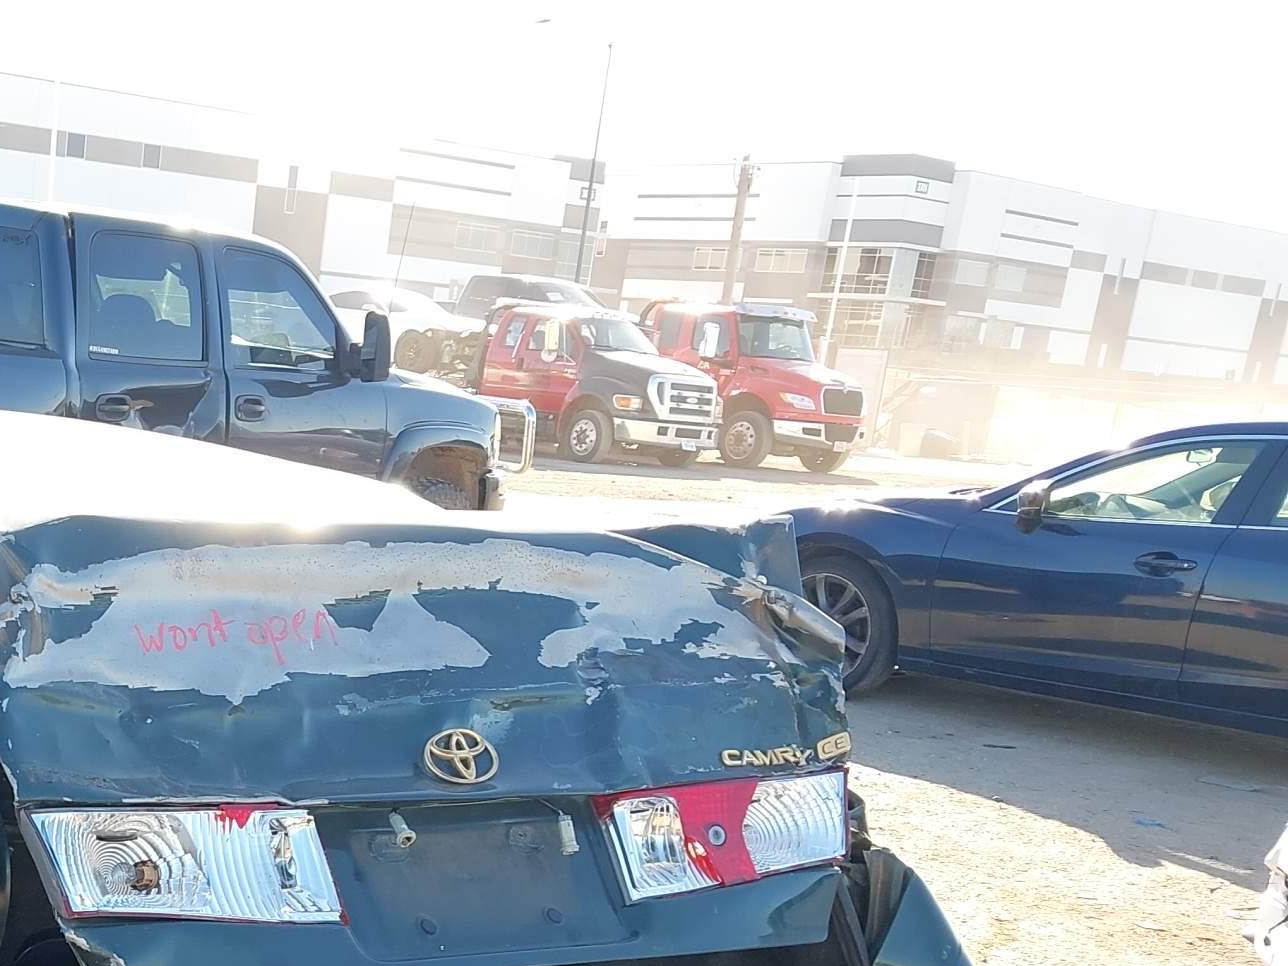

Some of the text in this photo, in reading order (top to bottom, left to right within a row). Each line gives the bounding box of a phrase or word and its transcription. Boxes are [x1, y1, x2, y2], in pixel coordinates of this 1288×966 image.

[243, 607, 339, 666] open
[720, 734, 849, 768] CAMRY CE
